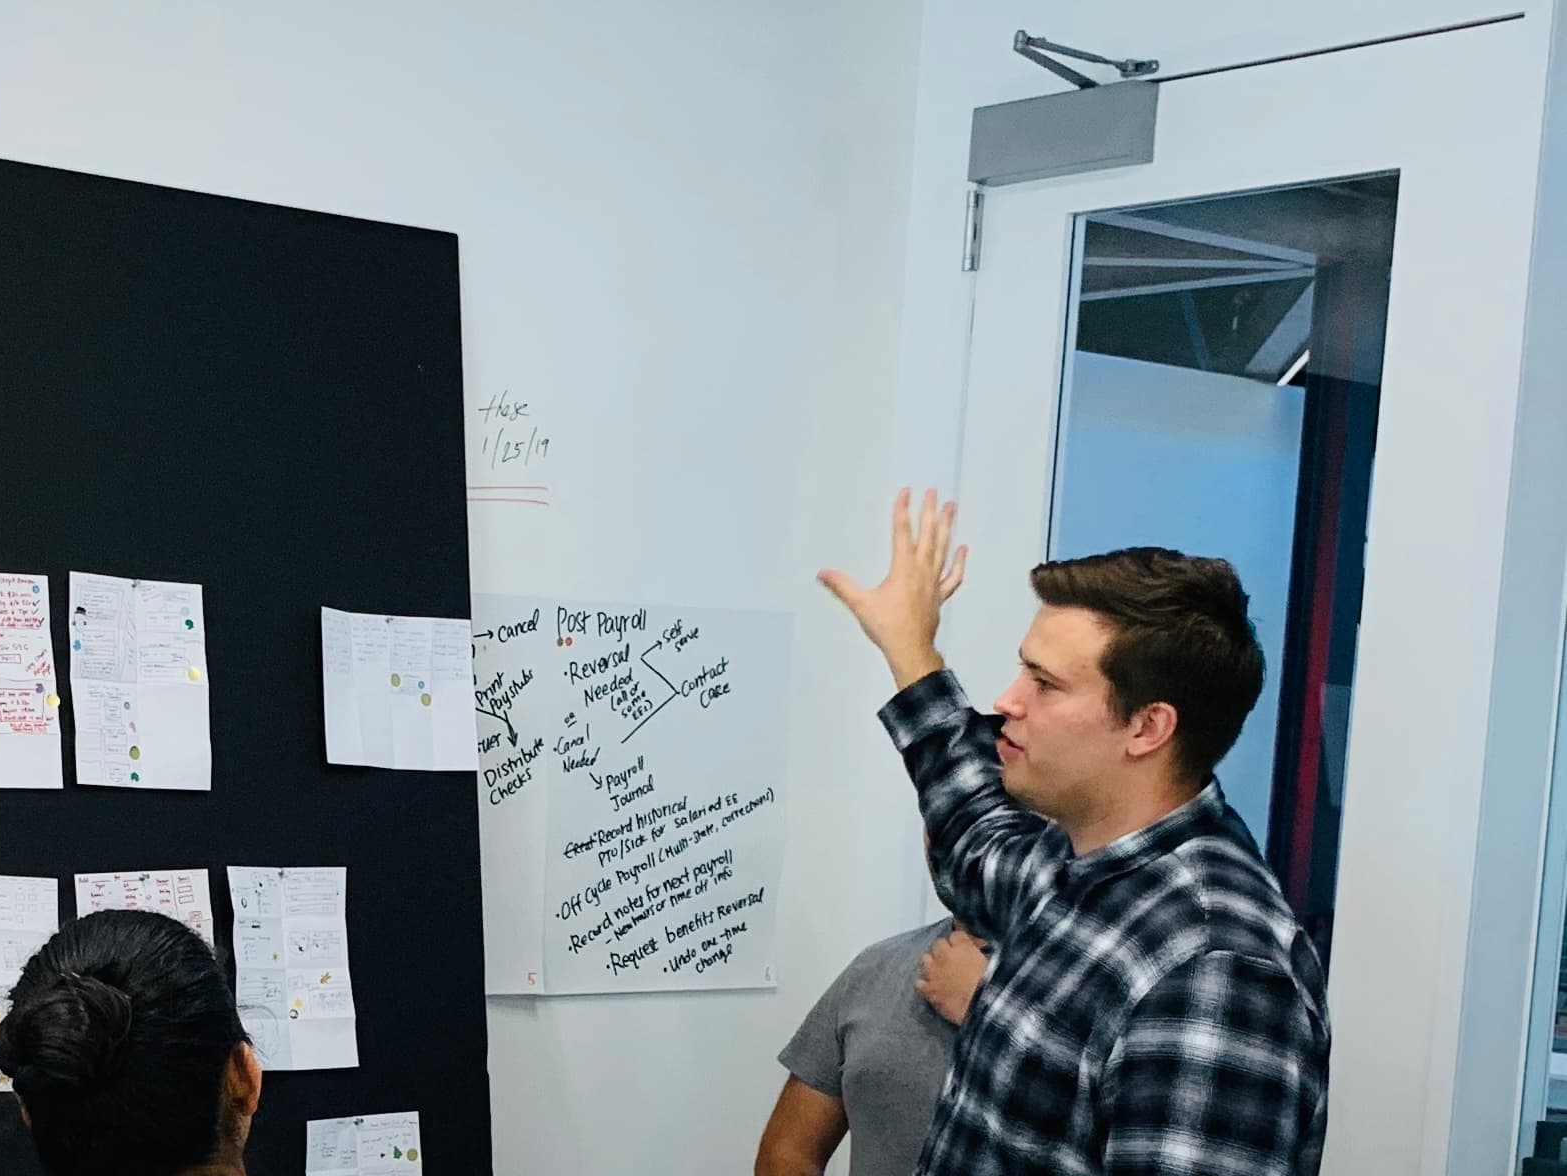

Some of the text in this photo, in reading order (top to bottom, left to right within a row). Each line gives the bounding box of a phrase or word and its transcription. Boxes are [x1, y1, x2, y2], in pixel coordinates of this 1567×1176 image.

[497, 608, 541, 643] Cancel
[556, 606, 648, 642] Post Payroll
[568, 643, 631, 685] Reversal
[680, 656, 730, 698] Contact
[474, 671, 505, 707] Print
[583, 667, 635, 708] Needed
[560, 723, 591, 756] Cancel
[483, 737, 545, 788] Distribute
[562, 746, 602, 774] Needed
[489, 767, 533, 806] Checks
[609, 773, 655, 812] Journal
[597, 816, 633, 847] Record
[560, 891, 582, 921] Off
[571, 911, 613, 954] Record
[613, 896, 645, 921] notes
[662, 866, 690, 893] next
[692, 848, 734, 883] payroll
[609, 886, 766, 976] Request benefits Reversal
[695, 943, 734, 974] change
